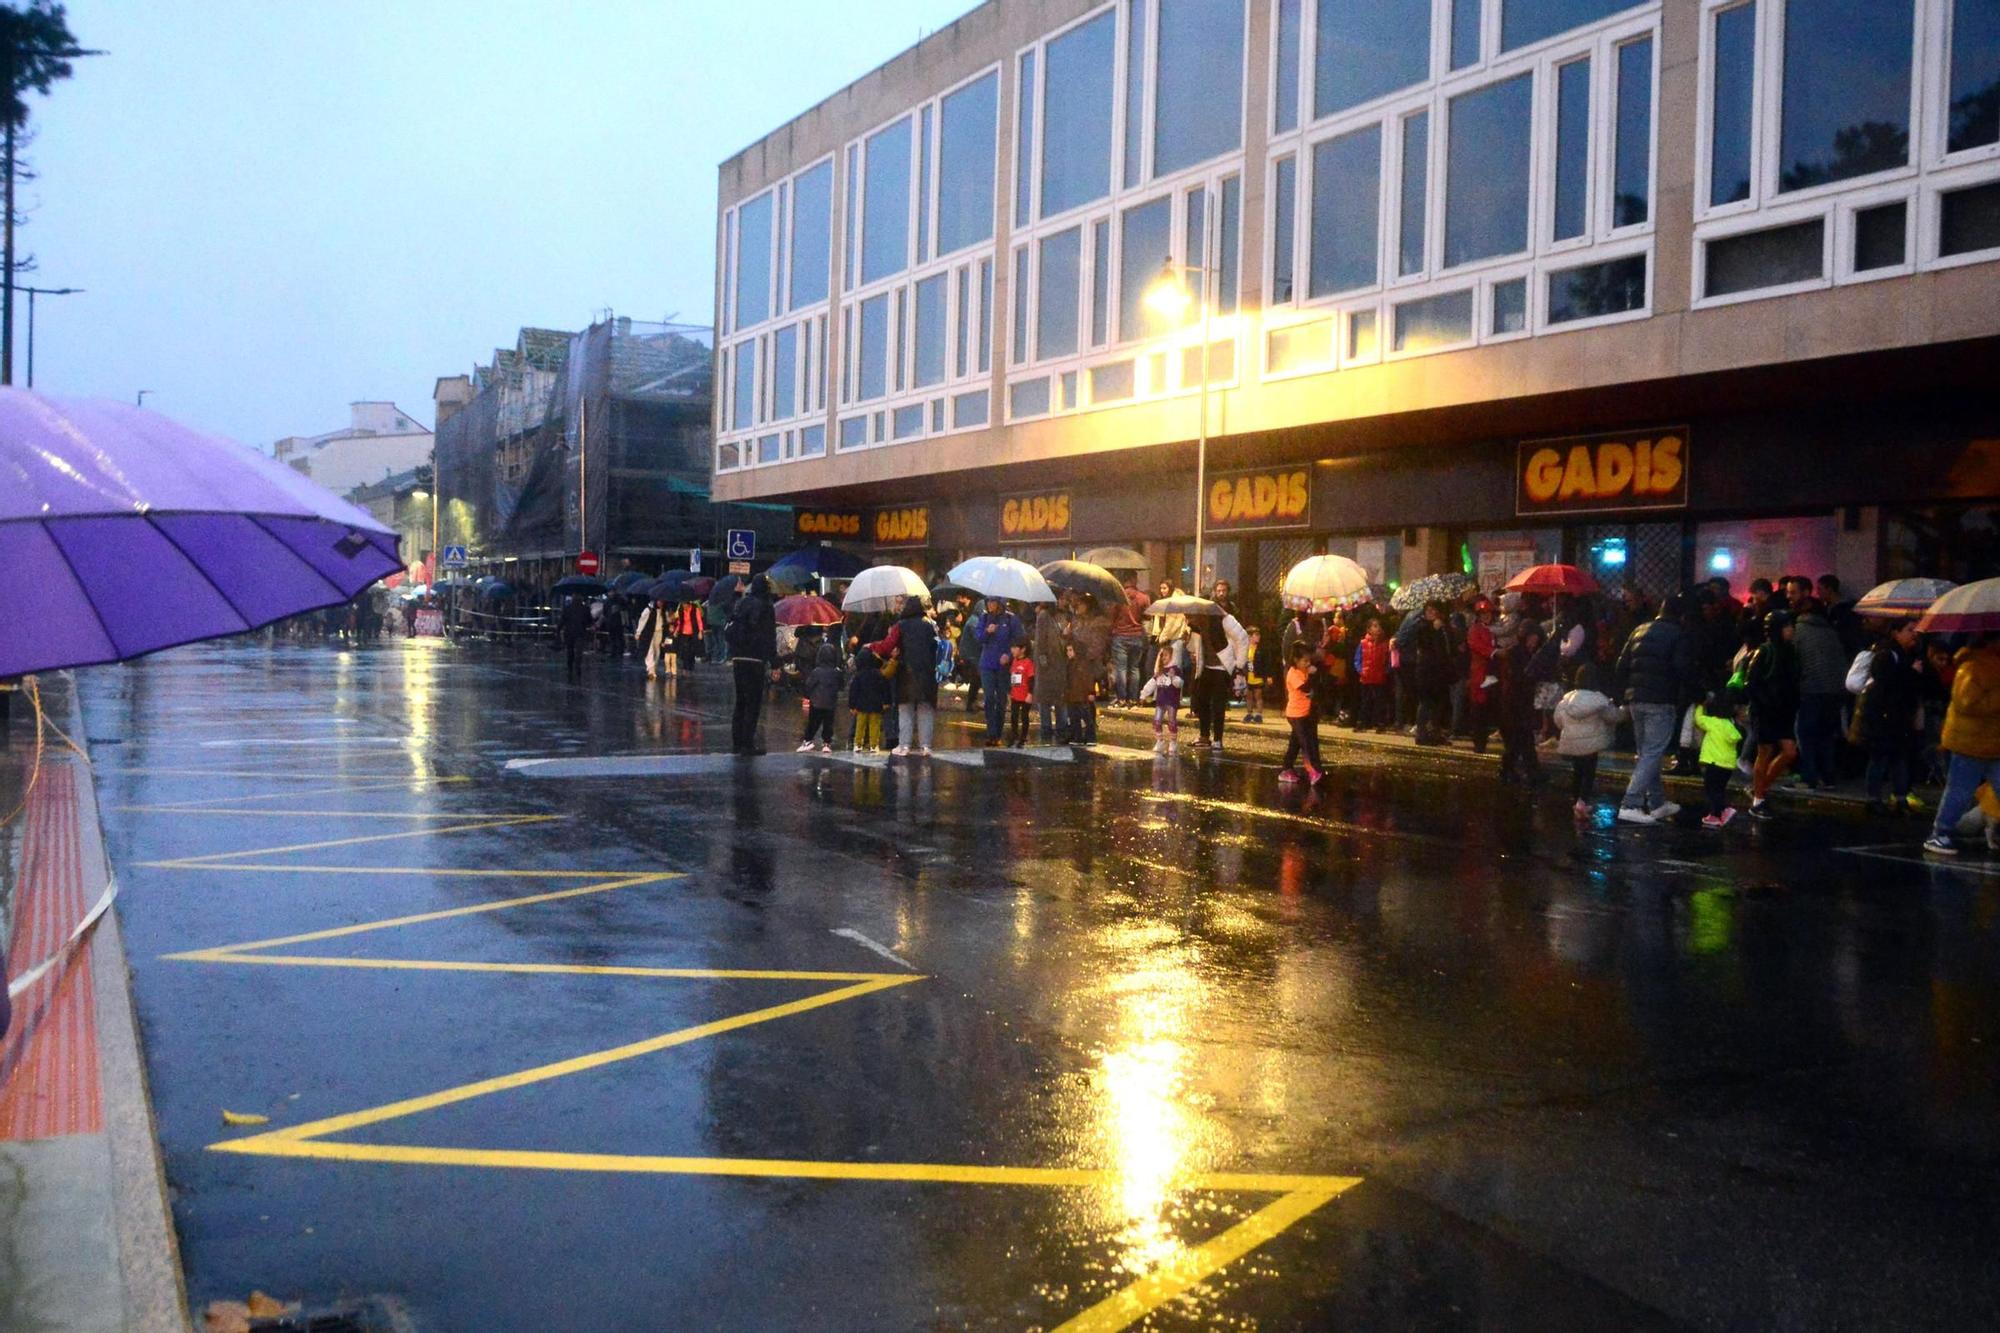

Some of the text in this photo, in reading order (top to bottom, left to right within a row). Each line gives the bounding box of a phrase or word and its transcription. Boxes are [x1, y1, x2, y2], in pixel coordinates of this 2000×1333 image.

[1525, 436, 1683, 503] GADIS
[1002, 495, 1069, 533] GADIS
[1209, 473, 1307, 521] GADIS
[798, 513, 860, 534] GADIS
[876, 508, 927, 540] GADIS
